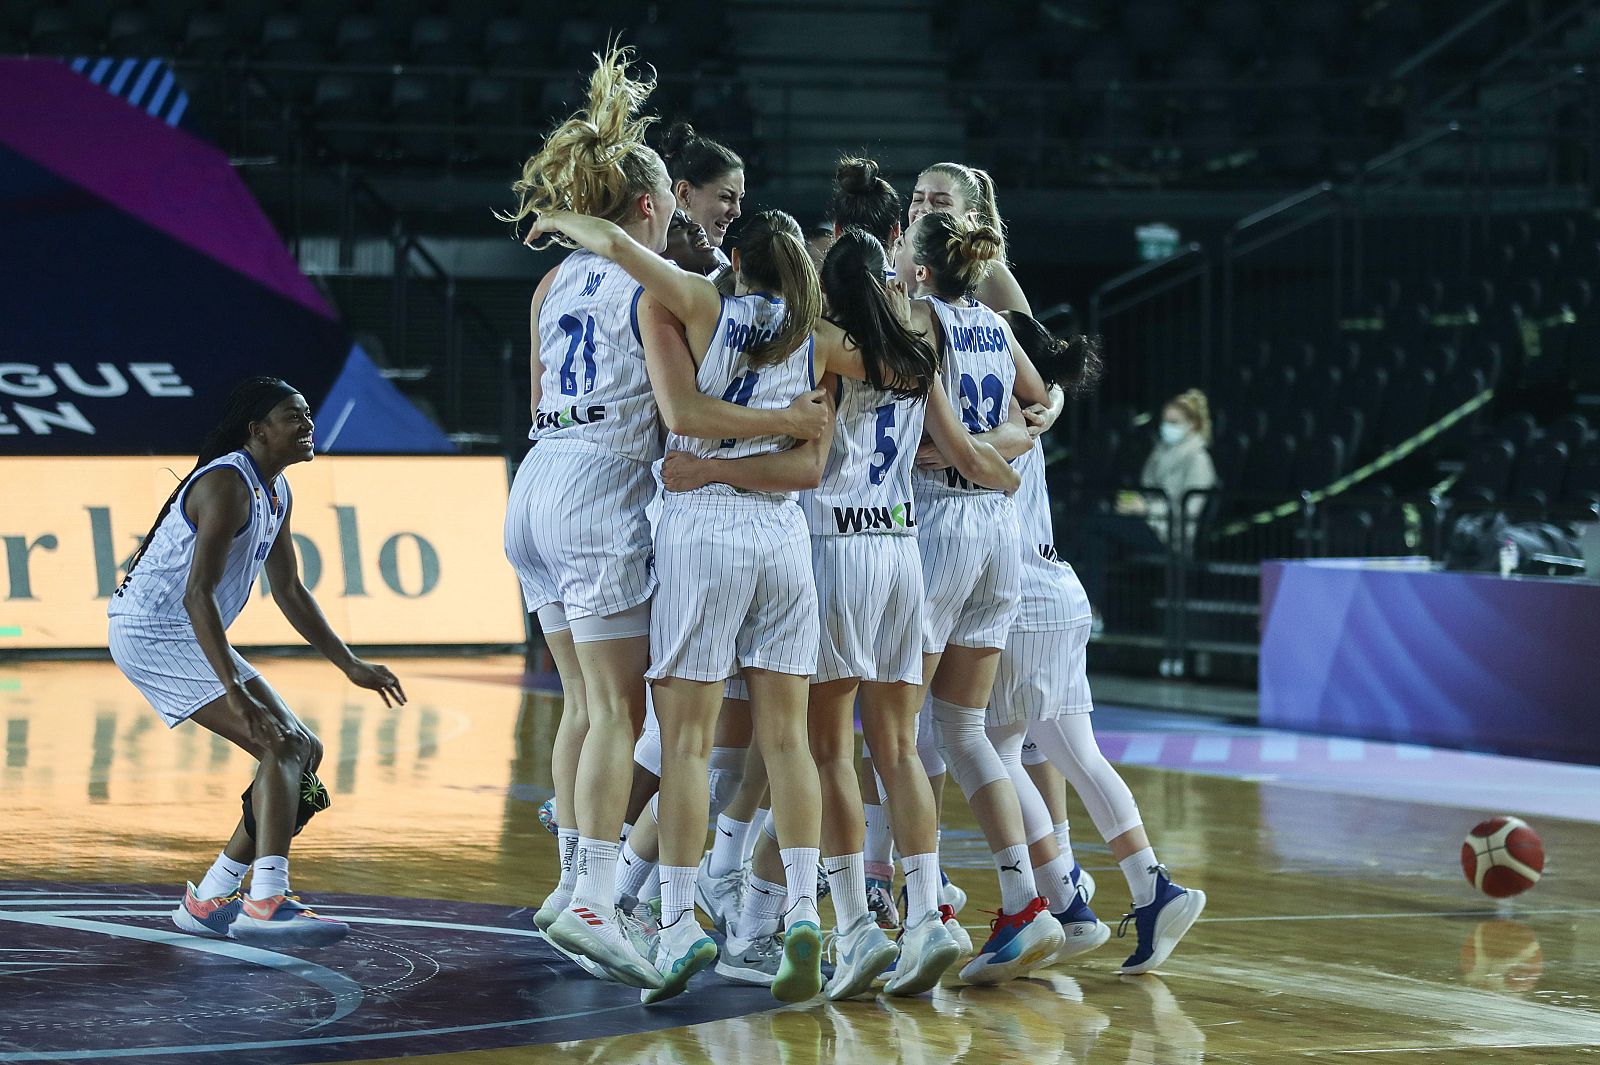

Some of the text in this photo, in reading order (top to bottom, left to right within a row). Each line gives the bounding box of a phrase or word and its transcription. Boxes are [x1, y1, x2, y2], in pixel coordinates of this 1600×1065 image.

[558, 313, 597, 397] 21
[726, 318, 778, 352] RODRÍG
[950, 324, 1007, 353] AMUELSO
[869, 402, 898, 486] 5
[833, 502, 917, 533] WINKL
[83, 504, 441, 600] klo
